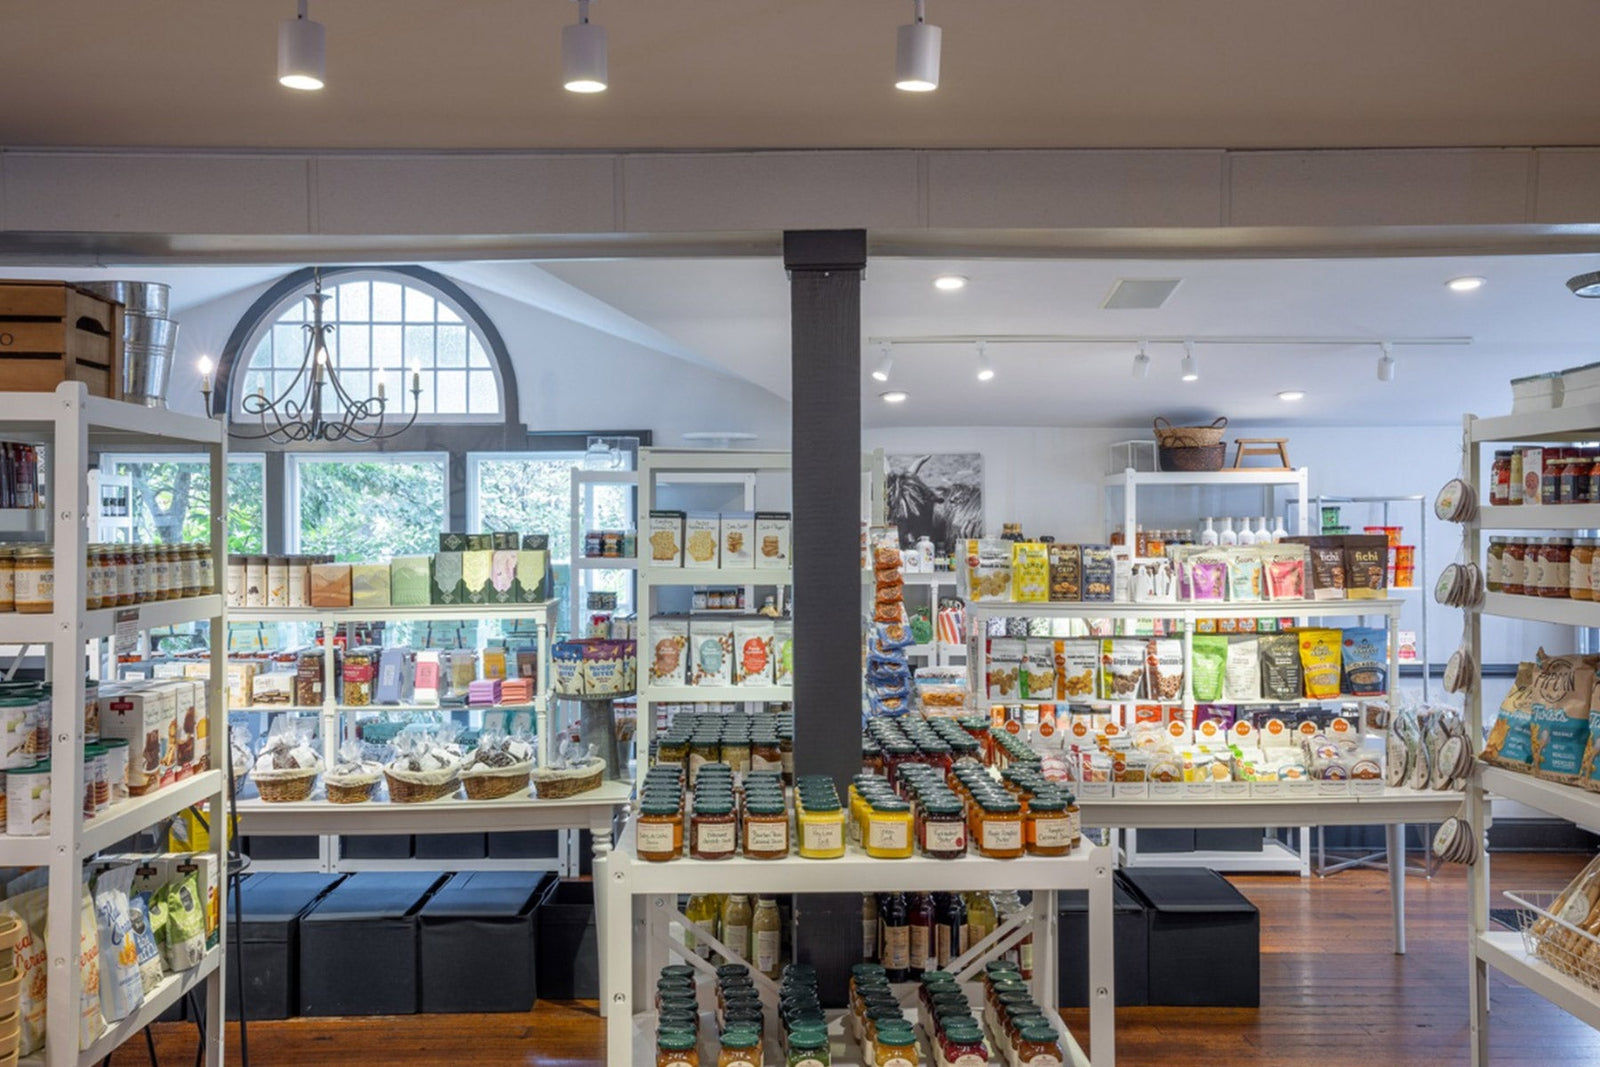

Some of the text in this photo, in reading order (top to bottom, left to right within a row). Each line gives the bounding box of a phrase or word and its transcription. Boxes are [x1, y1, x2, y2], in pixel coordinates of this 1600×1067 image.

[1319, 551, 1340, 561] fichi
[1354, 550, 1379, 561] fichi
[16, 948, 48, 978] Cerea
